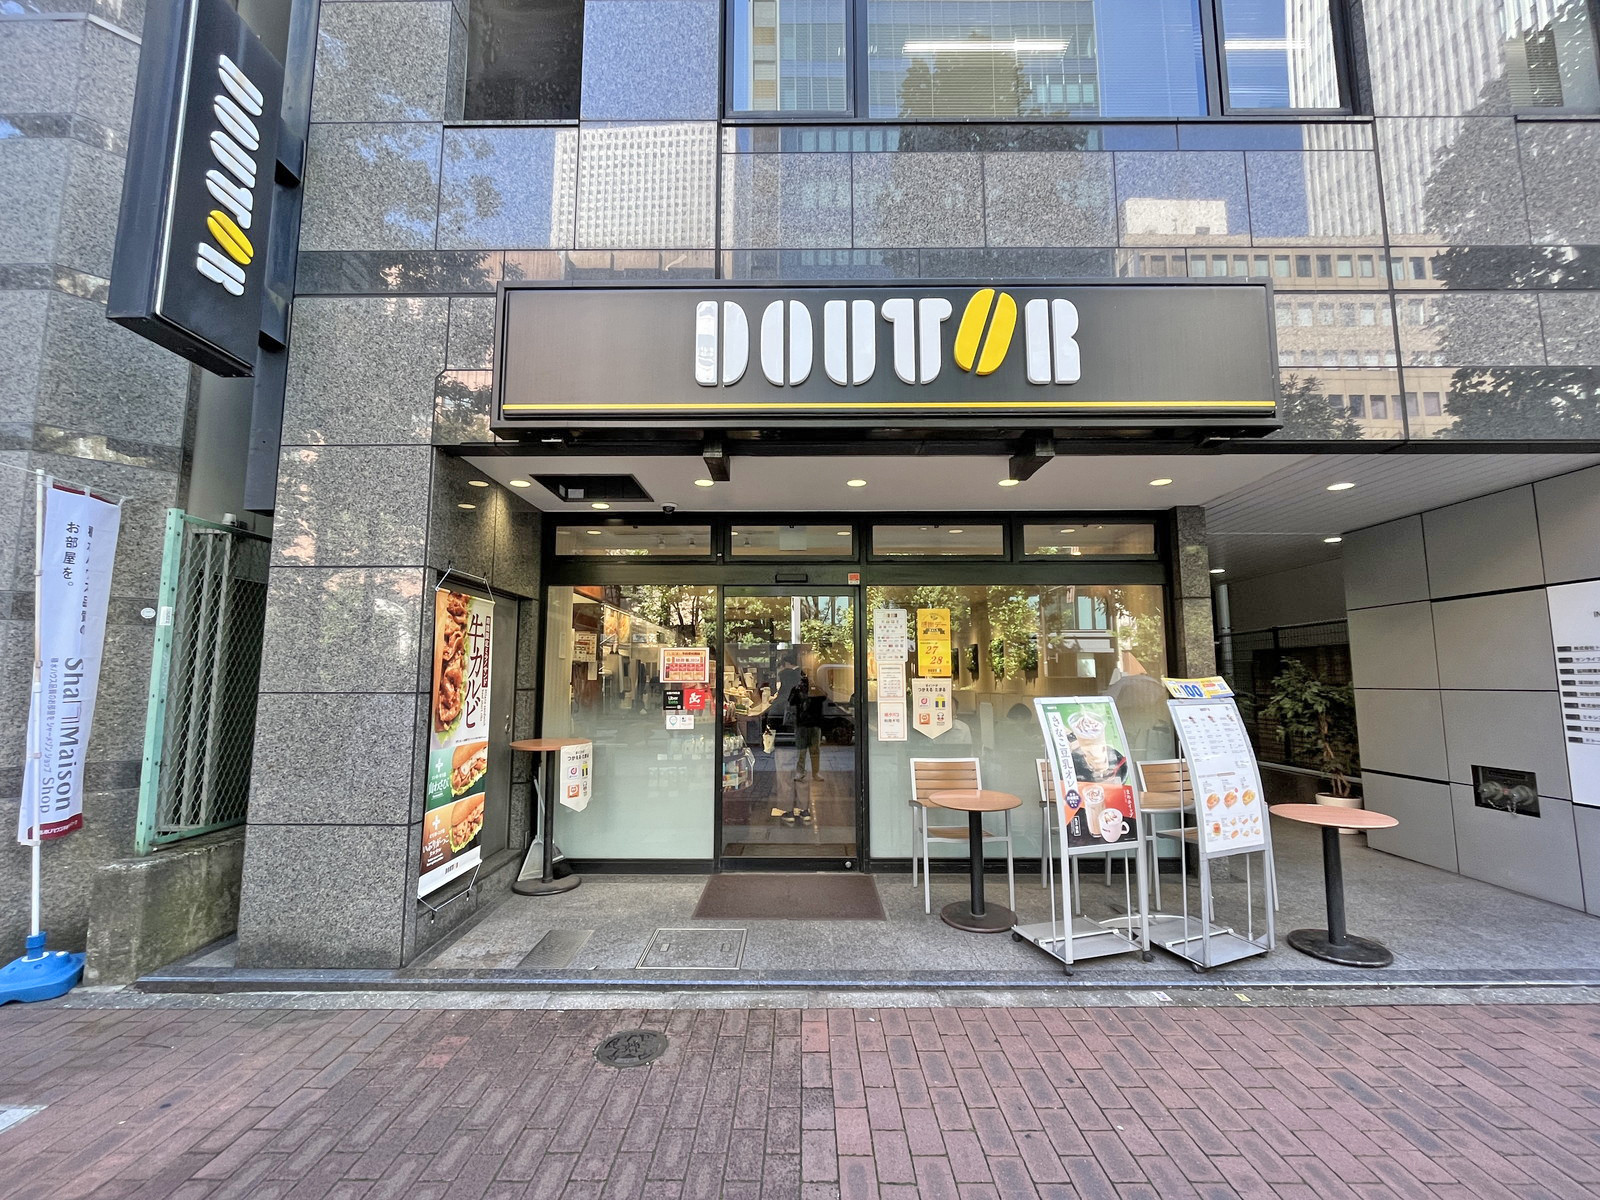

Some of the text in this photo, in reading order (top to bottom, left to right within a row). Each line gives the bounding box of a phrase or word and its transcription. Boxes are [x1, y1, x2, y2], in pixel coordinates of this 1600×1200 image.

[196, 54, 264, 297] DOUTOR
[694, 287, 1081, 387] DOUTOR
[62, 521, 81, 587] お部屋を。
[465, 613, 484, 729] 牛カルビ
[925, 645, 939, 655] 27
[929, 655, 943, 665] 28
[1179, 684, 1204, 698] 100
[54, 726, 80, 812] Maison
[1052, 714, 1075, 788] きなこ豆乳オレ
[39, 776, 55, 814] Shop
